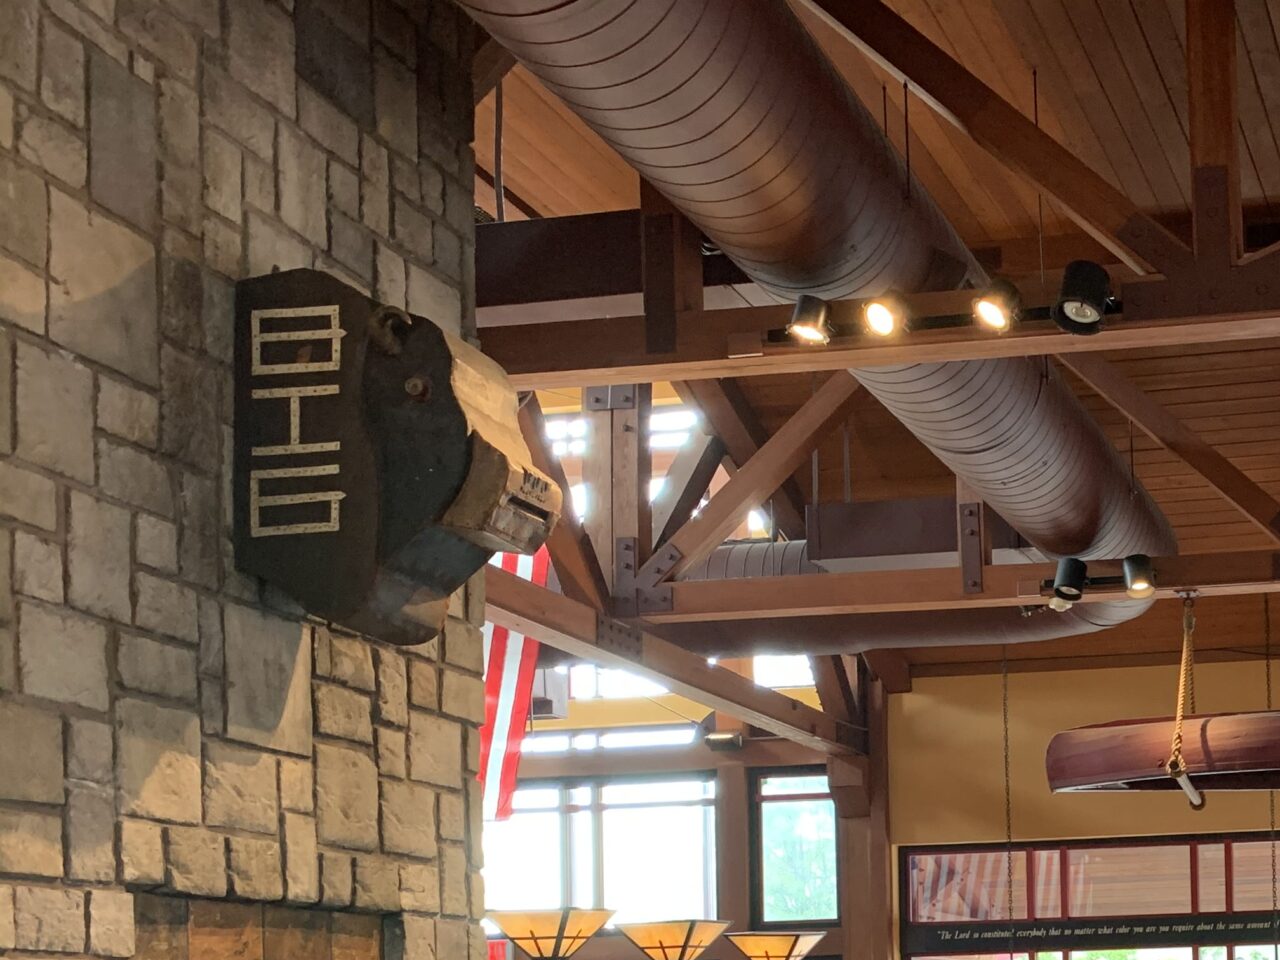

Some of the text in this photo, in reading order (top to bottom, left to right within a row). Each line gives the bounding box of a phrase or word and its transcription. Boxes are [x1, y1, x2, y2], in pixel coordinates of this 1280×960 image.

[955, 930, 970, 940] Lord
[1016, 927, 1046, 938] everybody
[1049, 926, 1061, 937] that
[1074, 927, 1095, 936] matter
[1098, 925, 1113, 935] what
[1115, 924, 1129, 934] color
[1133, 926, 1143, 935] you
[1159, 925, 1169, 934] you
[1172, 923, 1194, 933] require
[1197, 921, 1213, 931] about
[1216, 921, 1226, 931] the
[1247, 921, 1271, 929] amount
